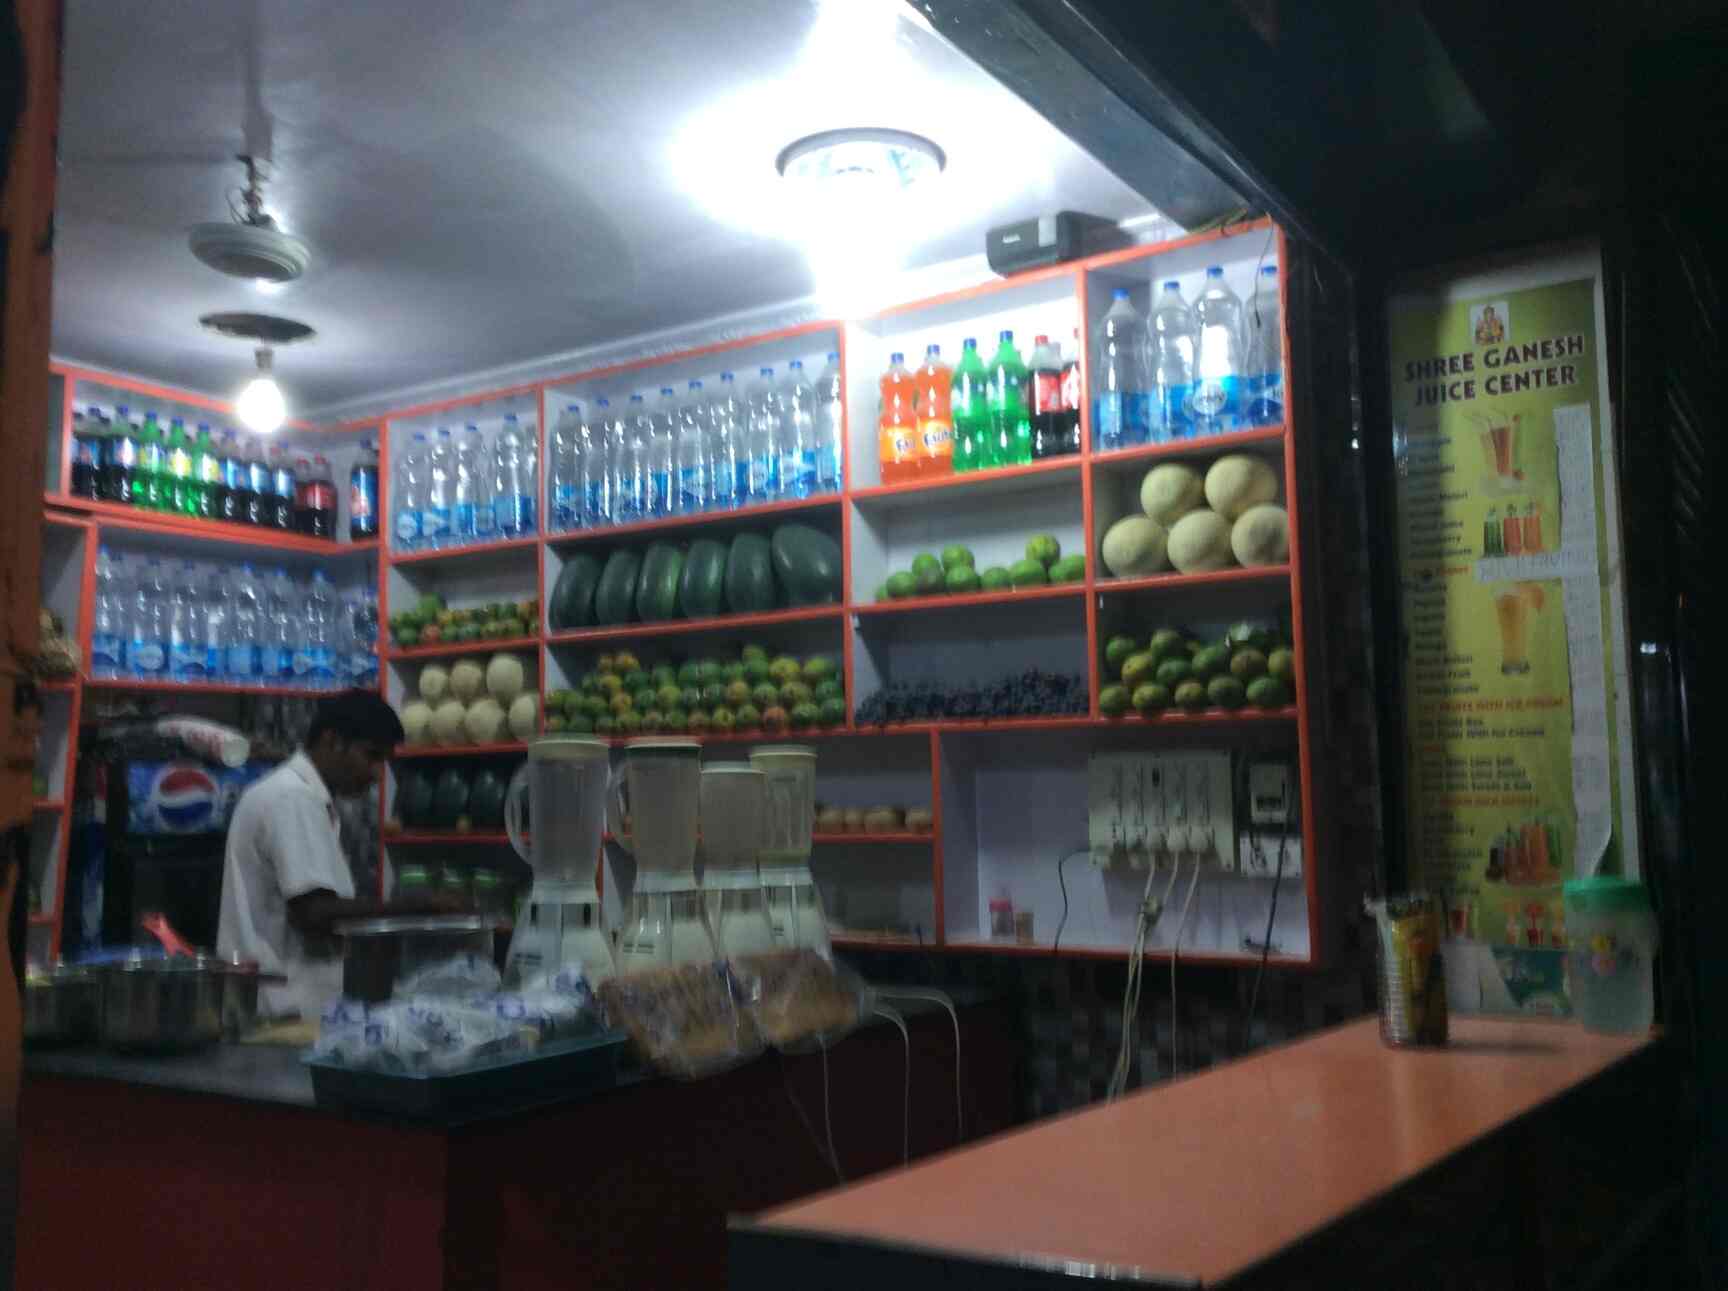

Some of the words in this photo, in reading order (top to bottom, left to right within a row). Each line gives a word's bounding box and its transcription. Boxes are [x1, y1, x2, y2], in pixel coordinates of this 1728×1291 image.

[1405, 352, 1475, 382] SHREE
[1484, 335, 1584, 368] GANESH
[1415, 380, 1476, 406] JUICE
[1484, 365, 1576, 395] CENTER
